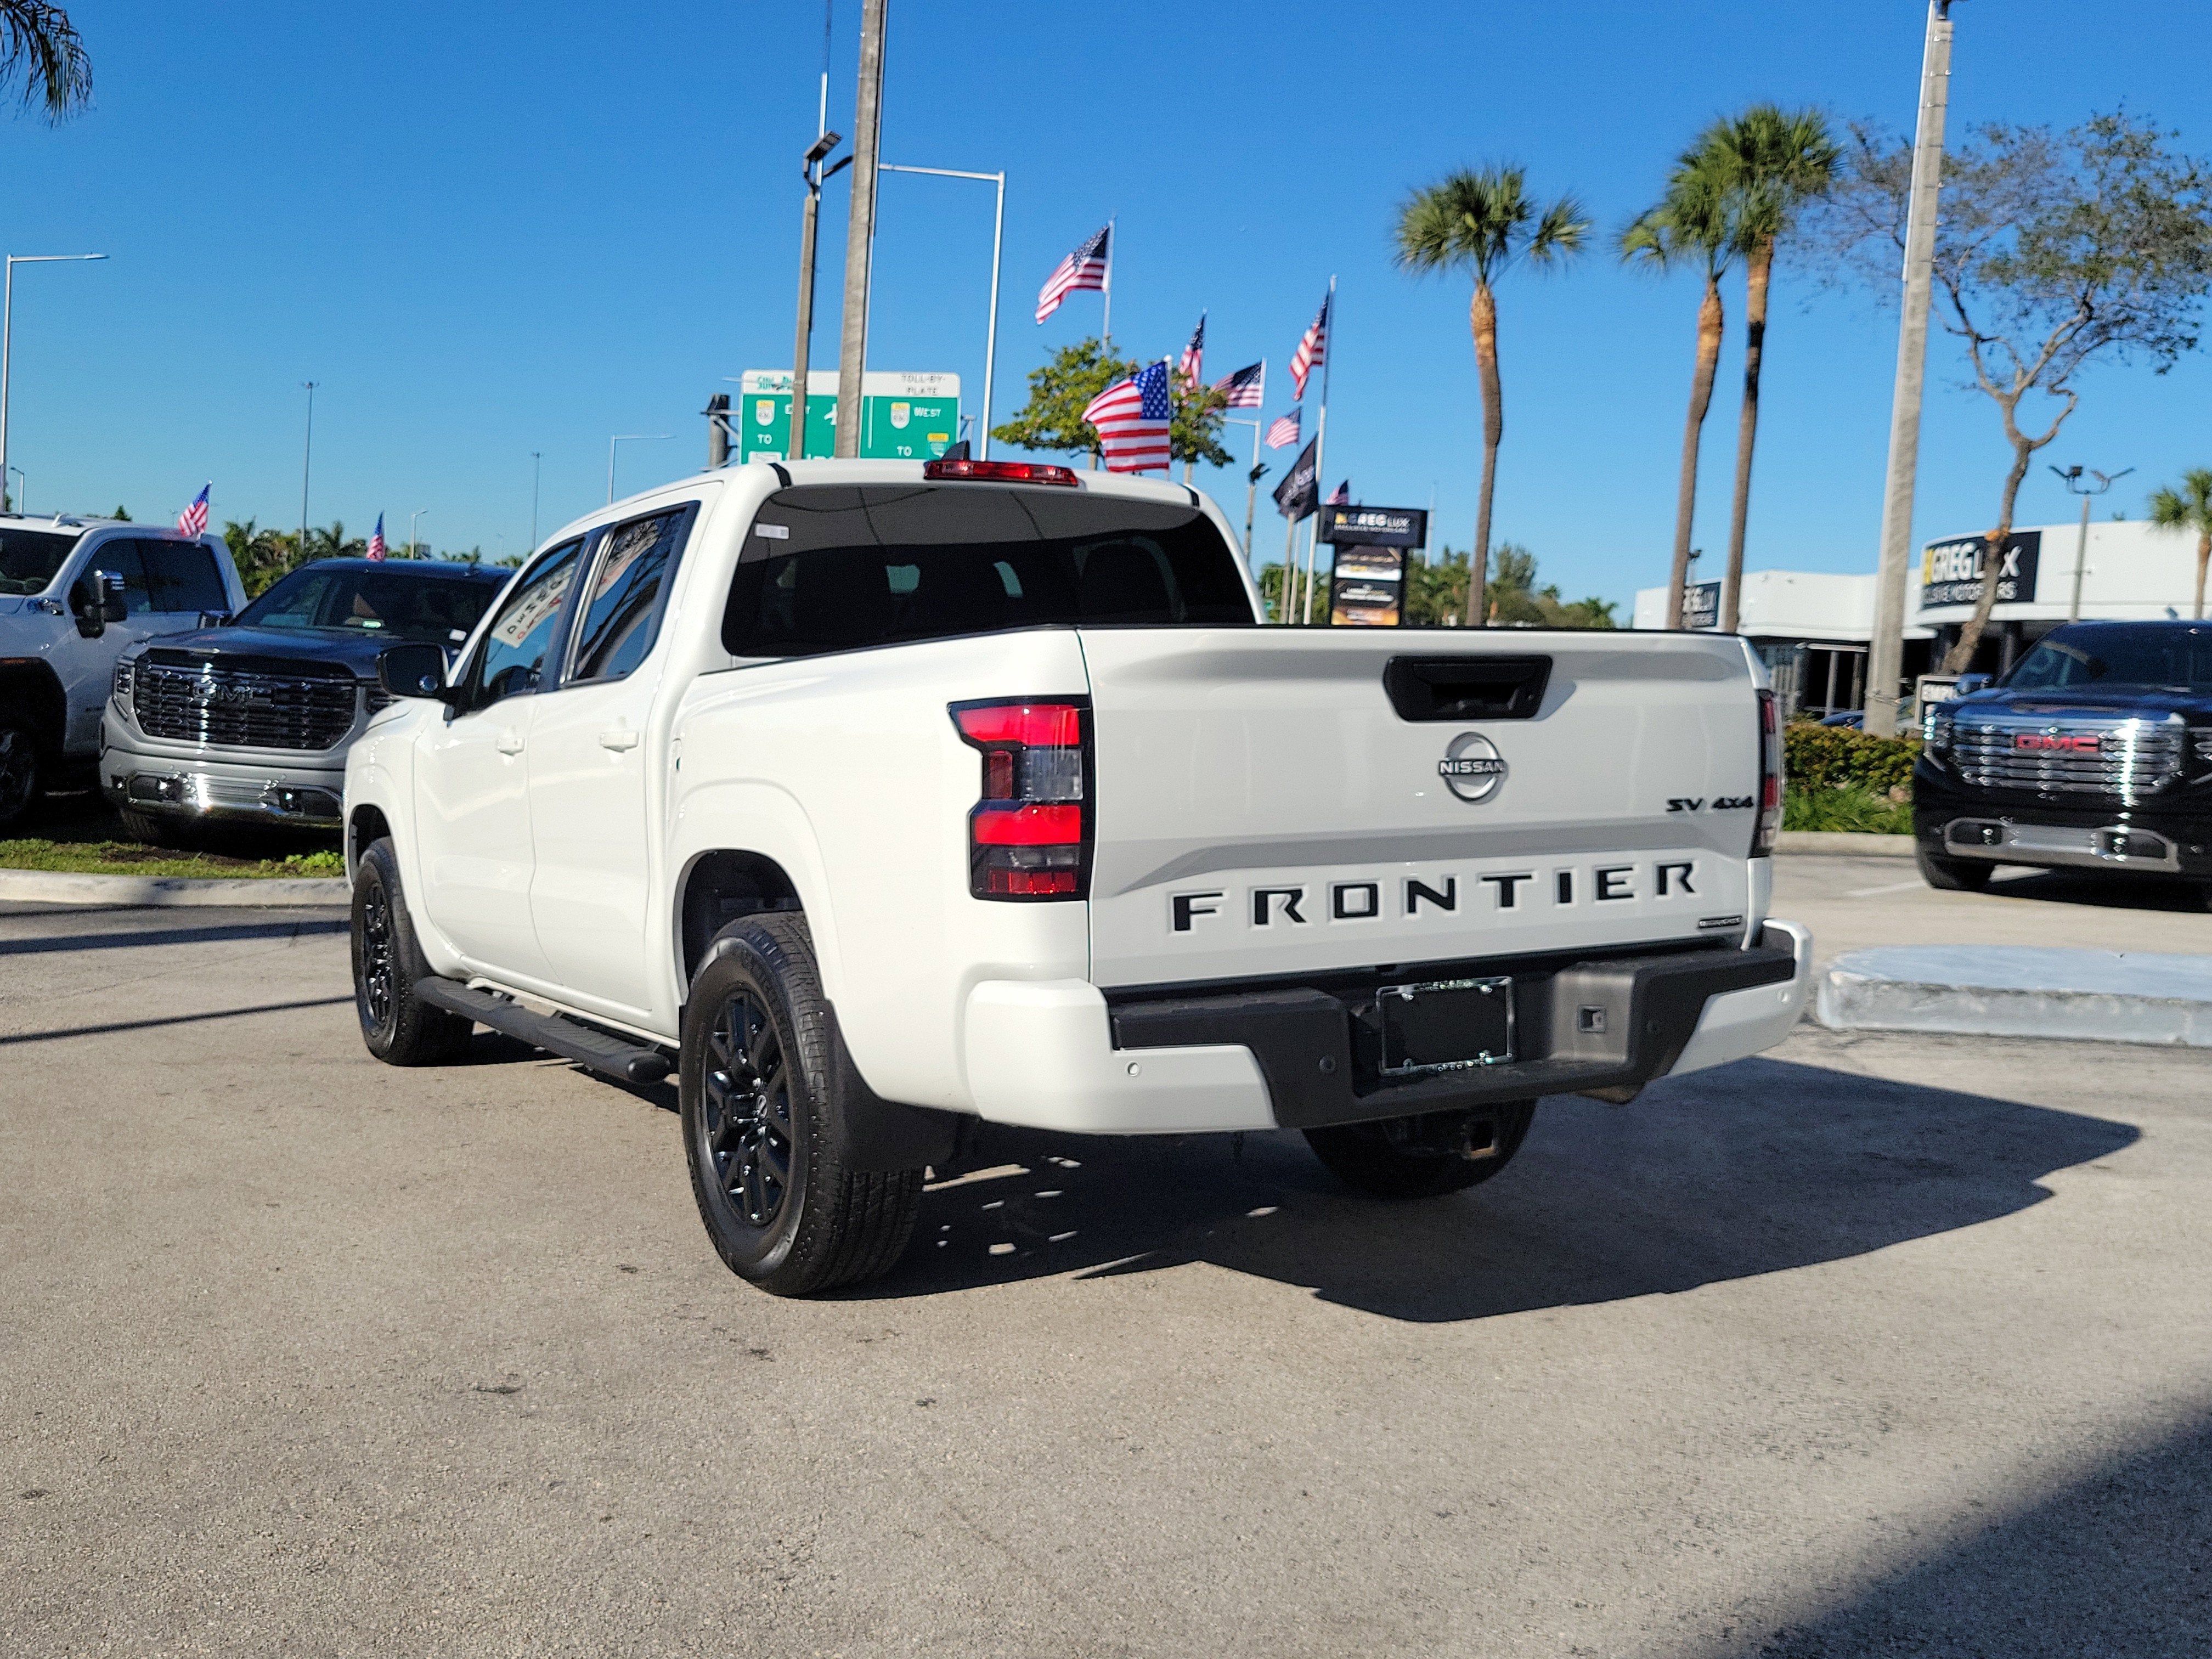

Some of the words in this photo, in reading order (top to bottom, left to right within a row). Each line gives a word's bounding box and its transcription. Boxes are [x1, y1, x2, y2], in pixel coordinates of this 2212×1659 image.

[913, 407, 942, 417] WEST
[757, 433, 772, 445] TO
[896, 445, 912, 457] TO
[1387, 517, 1410, 527] LUX
[1973, 546, 2023, 579] LX
[2016, 734, 2100, 752] GMC
[1440, 760, 1505, 774] NISSAN
[1666, 798, 1703, 812] SV
[1172, 862, 1696, 932] FRONTIER
